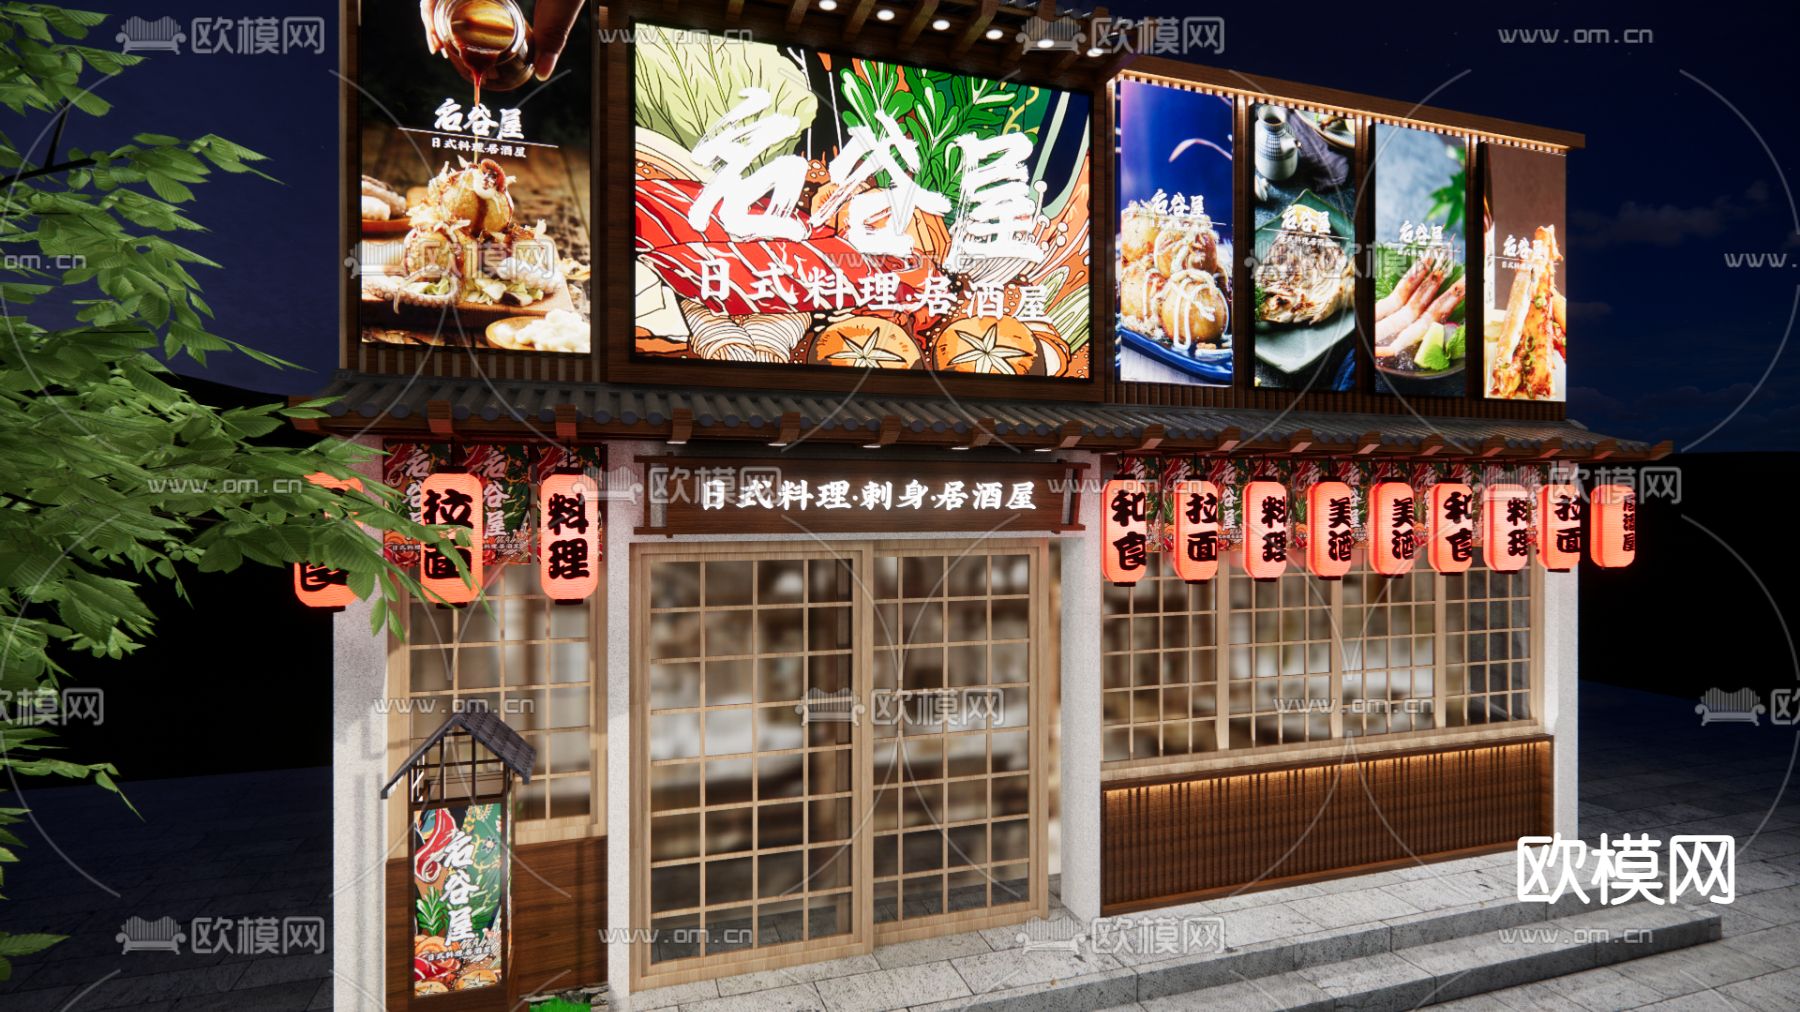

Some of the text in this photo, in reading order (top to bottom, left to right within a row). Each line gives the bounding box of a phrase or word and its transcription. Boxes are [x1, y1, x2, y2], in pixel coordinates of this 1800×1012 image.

[548, 493, 590, 580] 料理
[1111, 490, 1146, 571] 和食
[1186, 493, 1218, 562] 拉面
[1328, 497, 1352, 562] 美酒
[1392, 497, 1414, 560] 美酒
